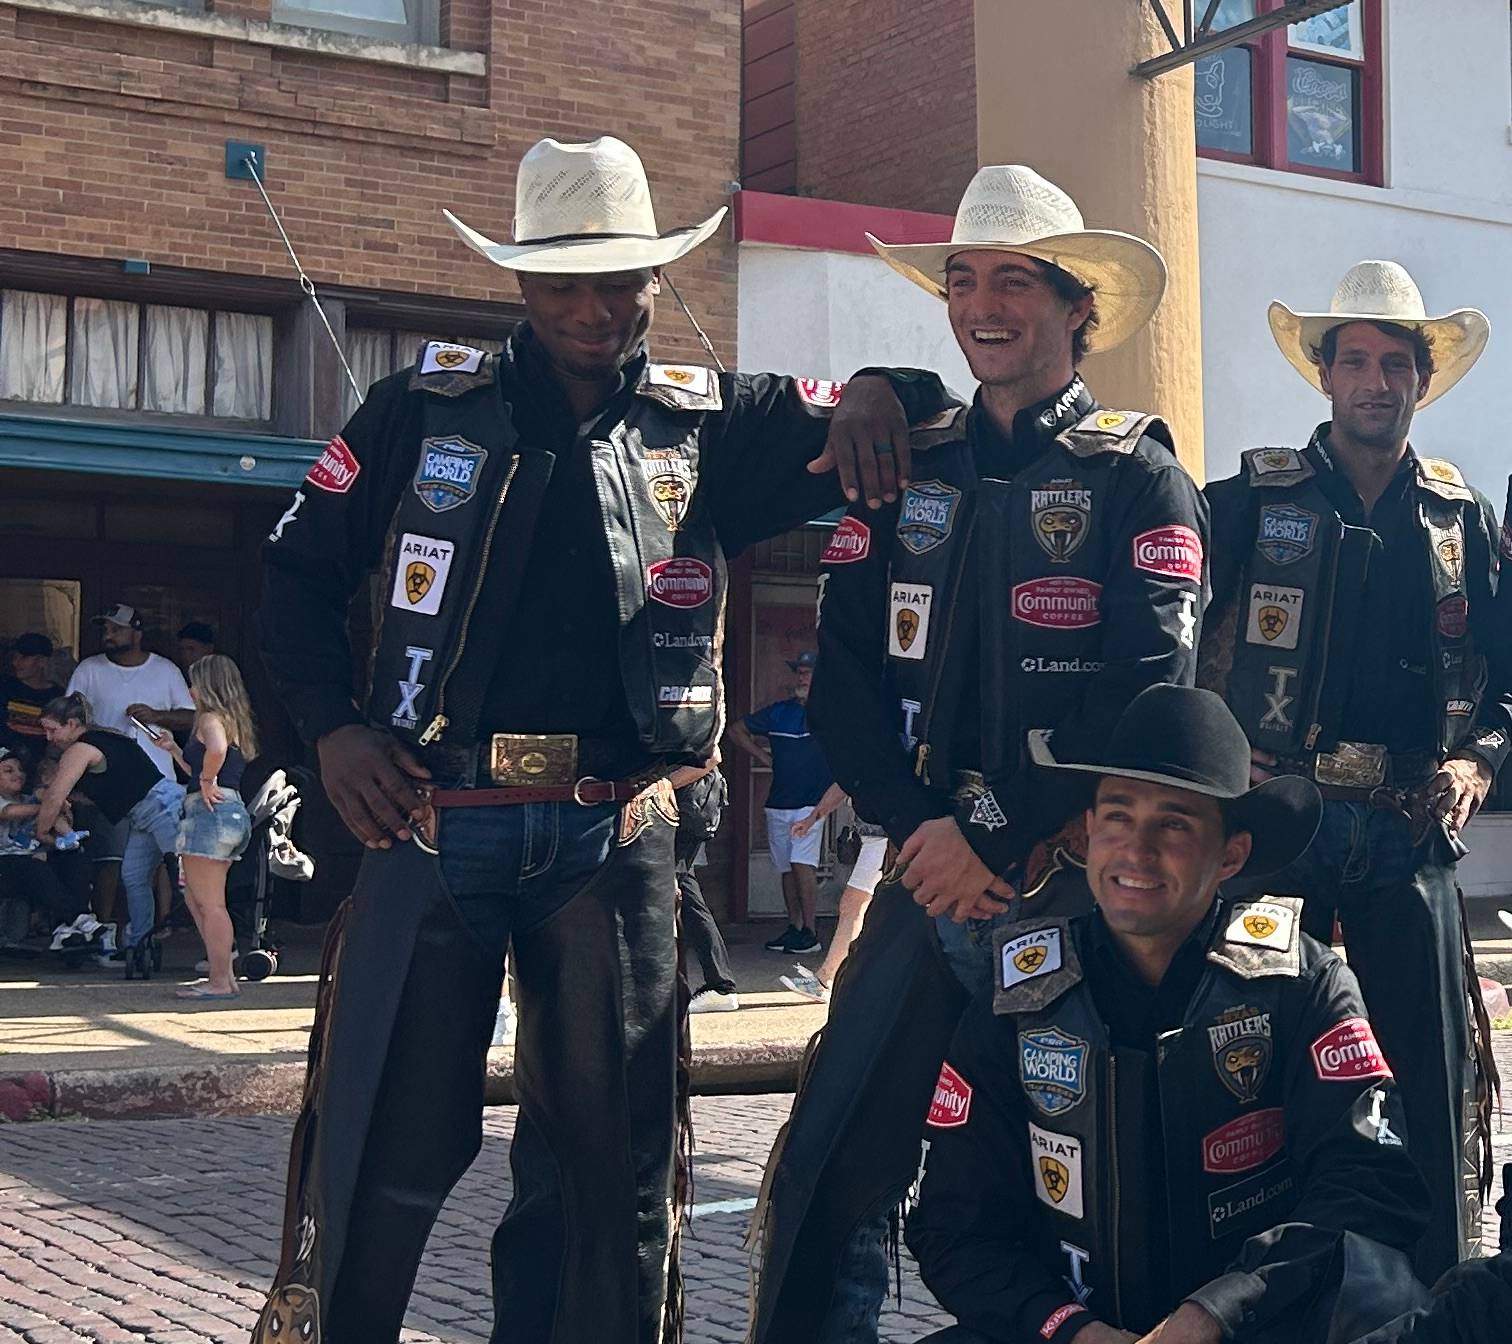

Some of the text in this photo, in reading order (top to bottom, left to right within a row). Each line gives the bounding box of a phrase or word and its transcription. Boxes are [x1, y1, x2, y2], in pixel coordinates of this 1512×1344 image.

[424, 464, 472, 482] WORLD
[1031, 489, 1092, 512] RATTLERS
[905, 507, 947, 525] WORLD
[403, 542, 450, 561] ARIAT
[893, 590, 930, 605] ARIAT
[1252, 590, 1301, 605] ARIAT
[1005, 931, 1060, 955] ARIAT
[1207, 1013, 1272, 1053] RATTLERS
[1023, 1048, 1078, 1067] CAMPING
[1023, 1060, 1077, 1082] WORLD
[1032, 1133, 1079, 1159] ARIAT
[1222, 1176, 1293, 1217] Land.com
